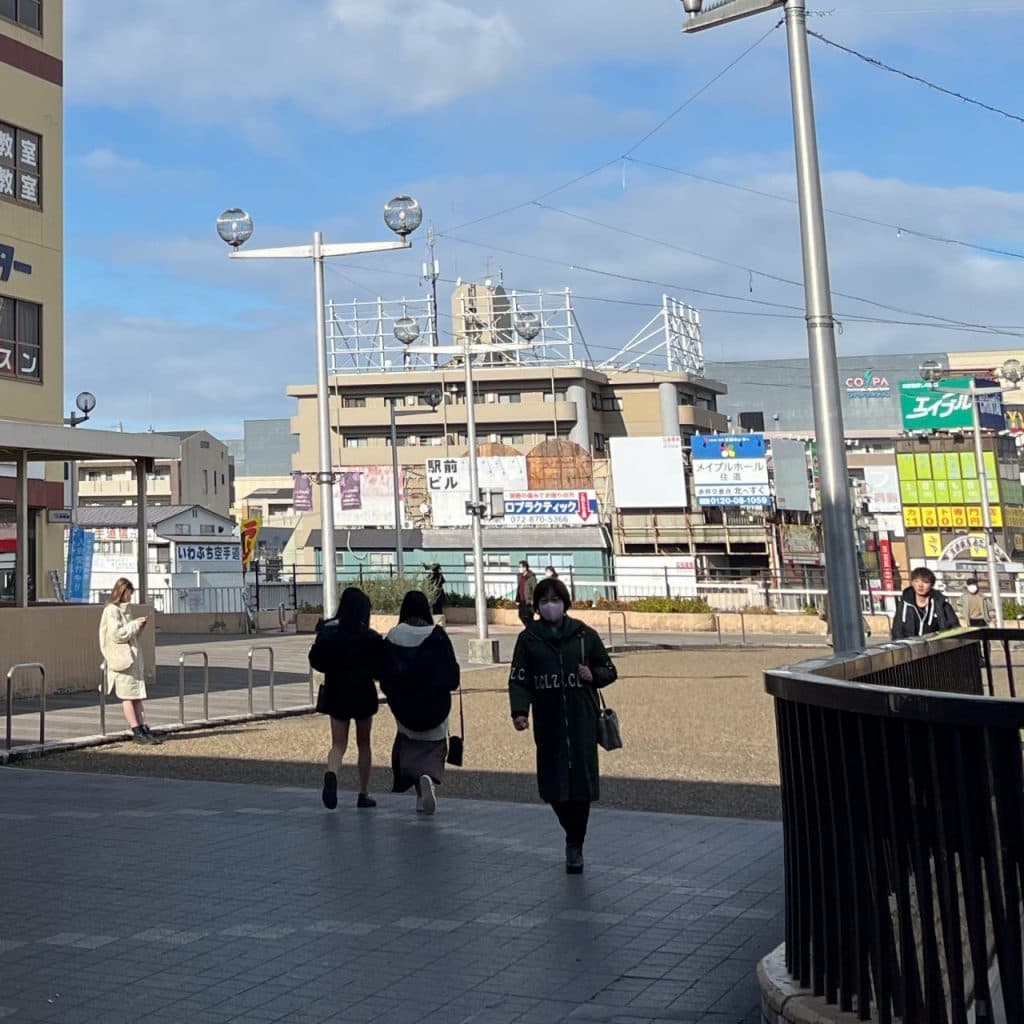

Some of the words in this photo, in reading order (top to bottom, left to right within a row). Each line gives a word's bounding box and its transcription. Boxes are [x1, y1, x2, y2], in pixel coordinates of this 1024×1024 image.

[905, 392, 973, 420] エイブル
[428, 459, 458, 474] 駅前
[696, 462, 765, 473] メイプルホール
[429, 477, 458, 490] ビル
[177, 545, 241, 560] いわぶち空手道
